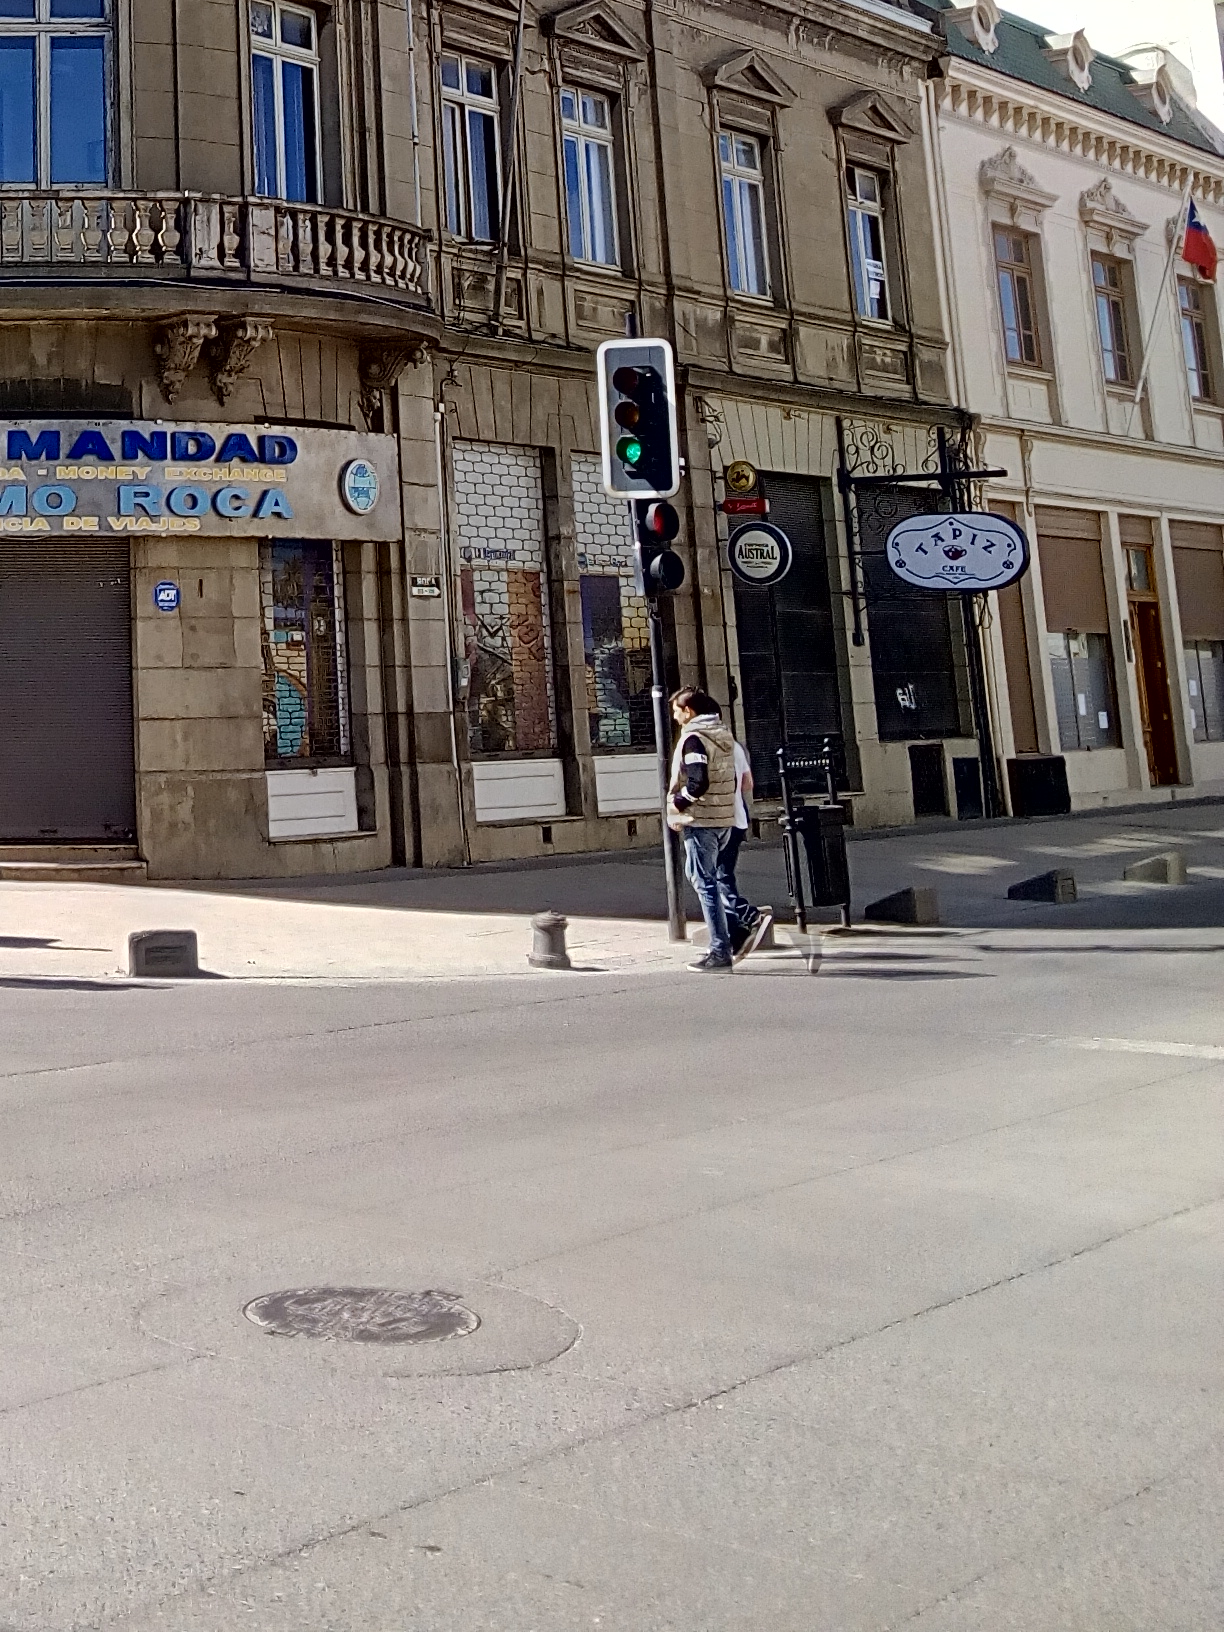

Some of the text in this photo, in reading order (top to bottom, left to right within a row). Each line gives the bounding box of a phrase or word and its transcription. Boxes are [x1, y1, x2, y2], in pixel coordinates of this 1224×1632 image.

[56, 466, 154, 481] MONEY
[165, 467, 287, 483] EXCHANGE
[117, 484, 295, 520] ROCA
[63, 516, 99, 531] DE
[107, 516, 202, 532] VIAJES
[915, 527, 997, 556] TAPIZ
[737, 544, 778, 561] AUSTRAL
[157, 589, 177, 601] ADT
